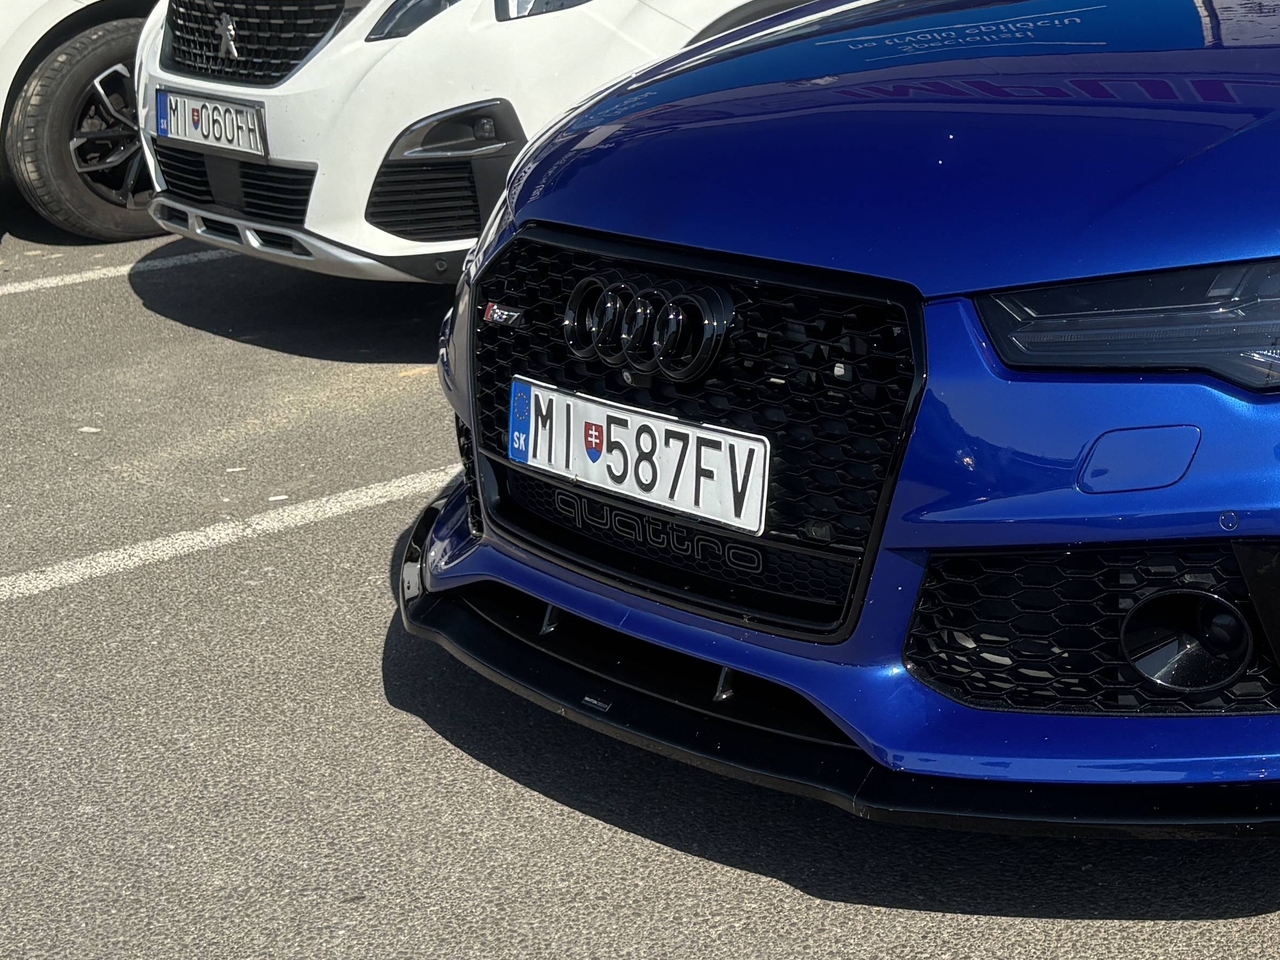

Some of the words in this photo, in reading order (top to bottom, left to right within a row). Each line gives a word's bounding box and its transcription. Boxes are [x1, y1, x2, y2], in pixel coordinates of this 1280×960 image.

[168, 95, 188, 137] MI
[512, 431, 527, 453] SK
[532, 390, 574, 470] MI
[604, 414, 756, 520] 587FV
[553, 489, 764, 574] quattro
